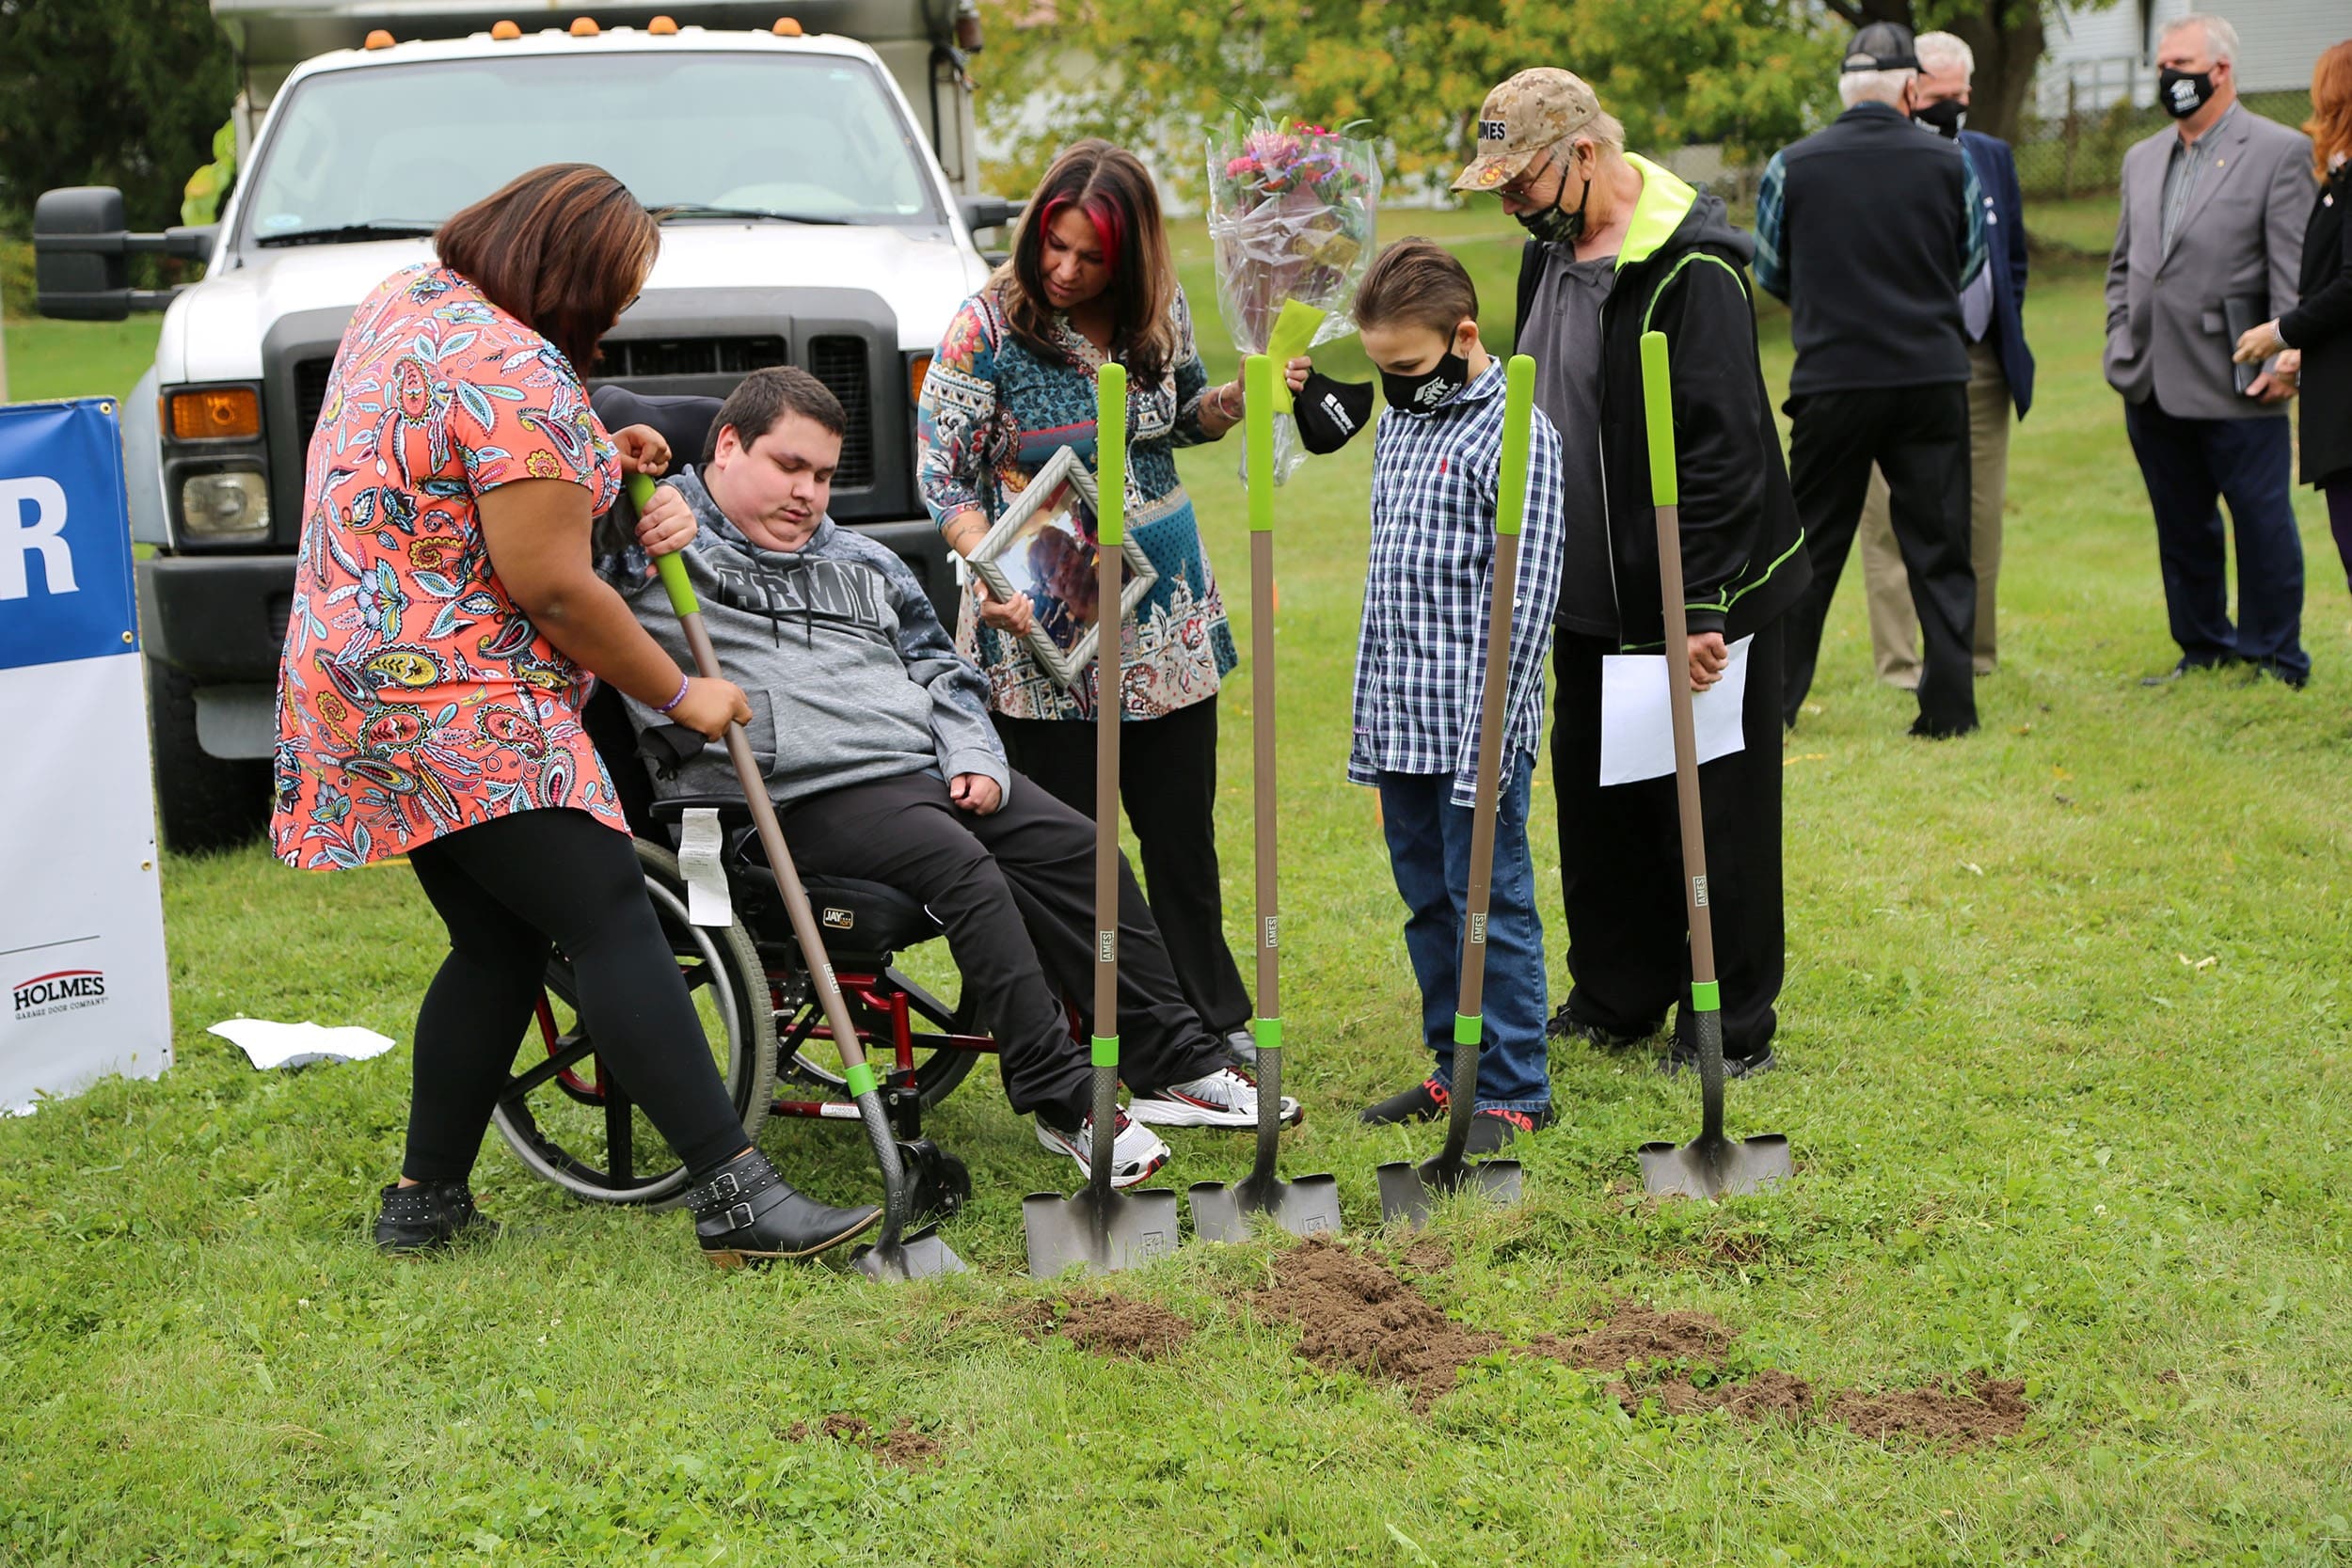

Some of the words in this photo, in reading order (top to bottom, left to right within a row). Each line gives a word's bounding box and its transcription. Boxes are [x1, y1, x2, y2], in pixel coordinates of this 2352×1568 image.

[713, 561, 881, 627] ARMY
[1695, 879, 1707, 904] AMES
[825, 911, 845, 923] JAY
[1474, 915, 1485, 942] AMES
[1268, 918, 1277, 944] AMES
[1102, 933, 1112, 959] AMES
[13, 977, 104, 1011] HOLMES
[15, 1009, 45, 1020] GARAGE
[47, 1004, 68, 1015] DOOR
